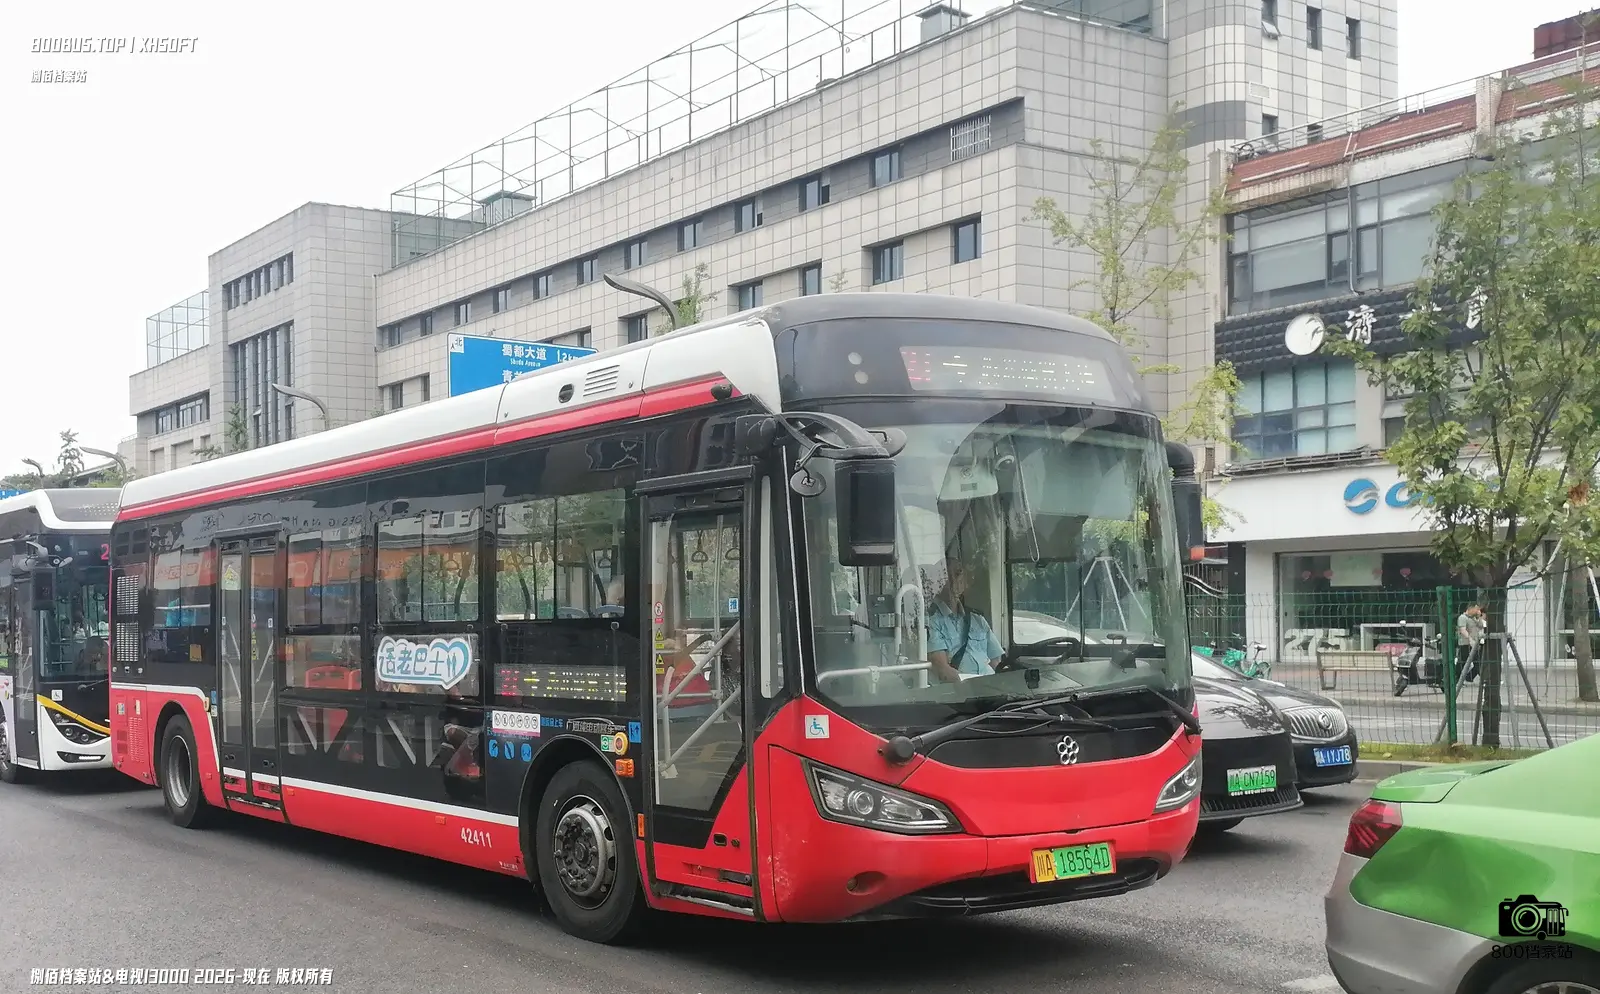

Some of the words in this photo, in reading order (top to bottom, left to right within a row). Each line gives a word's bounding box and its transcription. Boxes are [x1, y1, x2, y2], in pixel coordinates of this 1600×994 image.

[455, 338, 463, 347] 北
[502, 343, 547, 361] 蜀都大道
[461, 827, 492, 848] 42411
